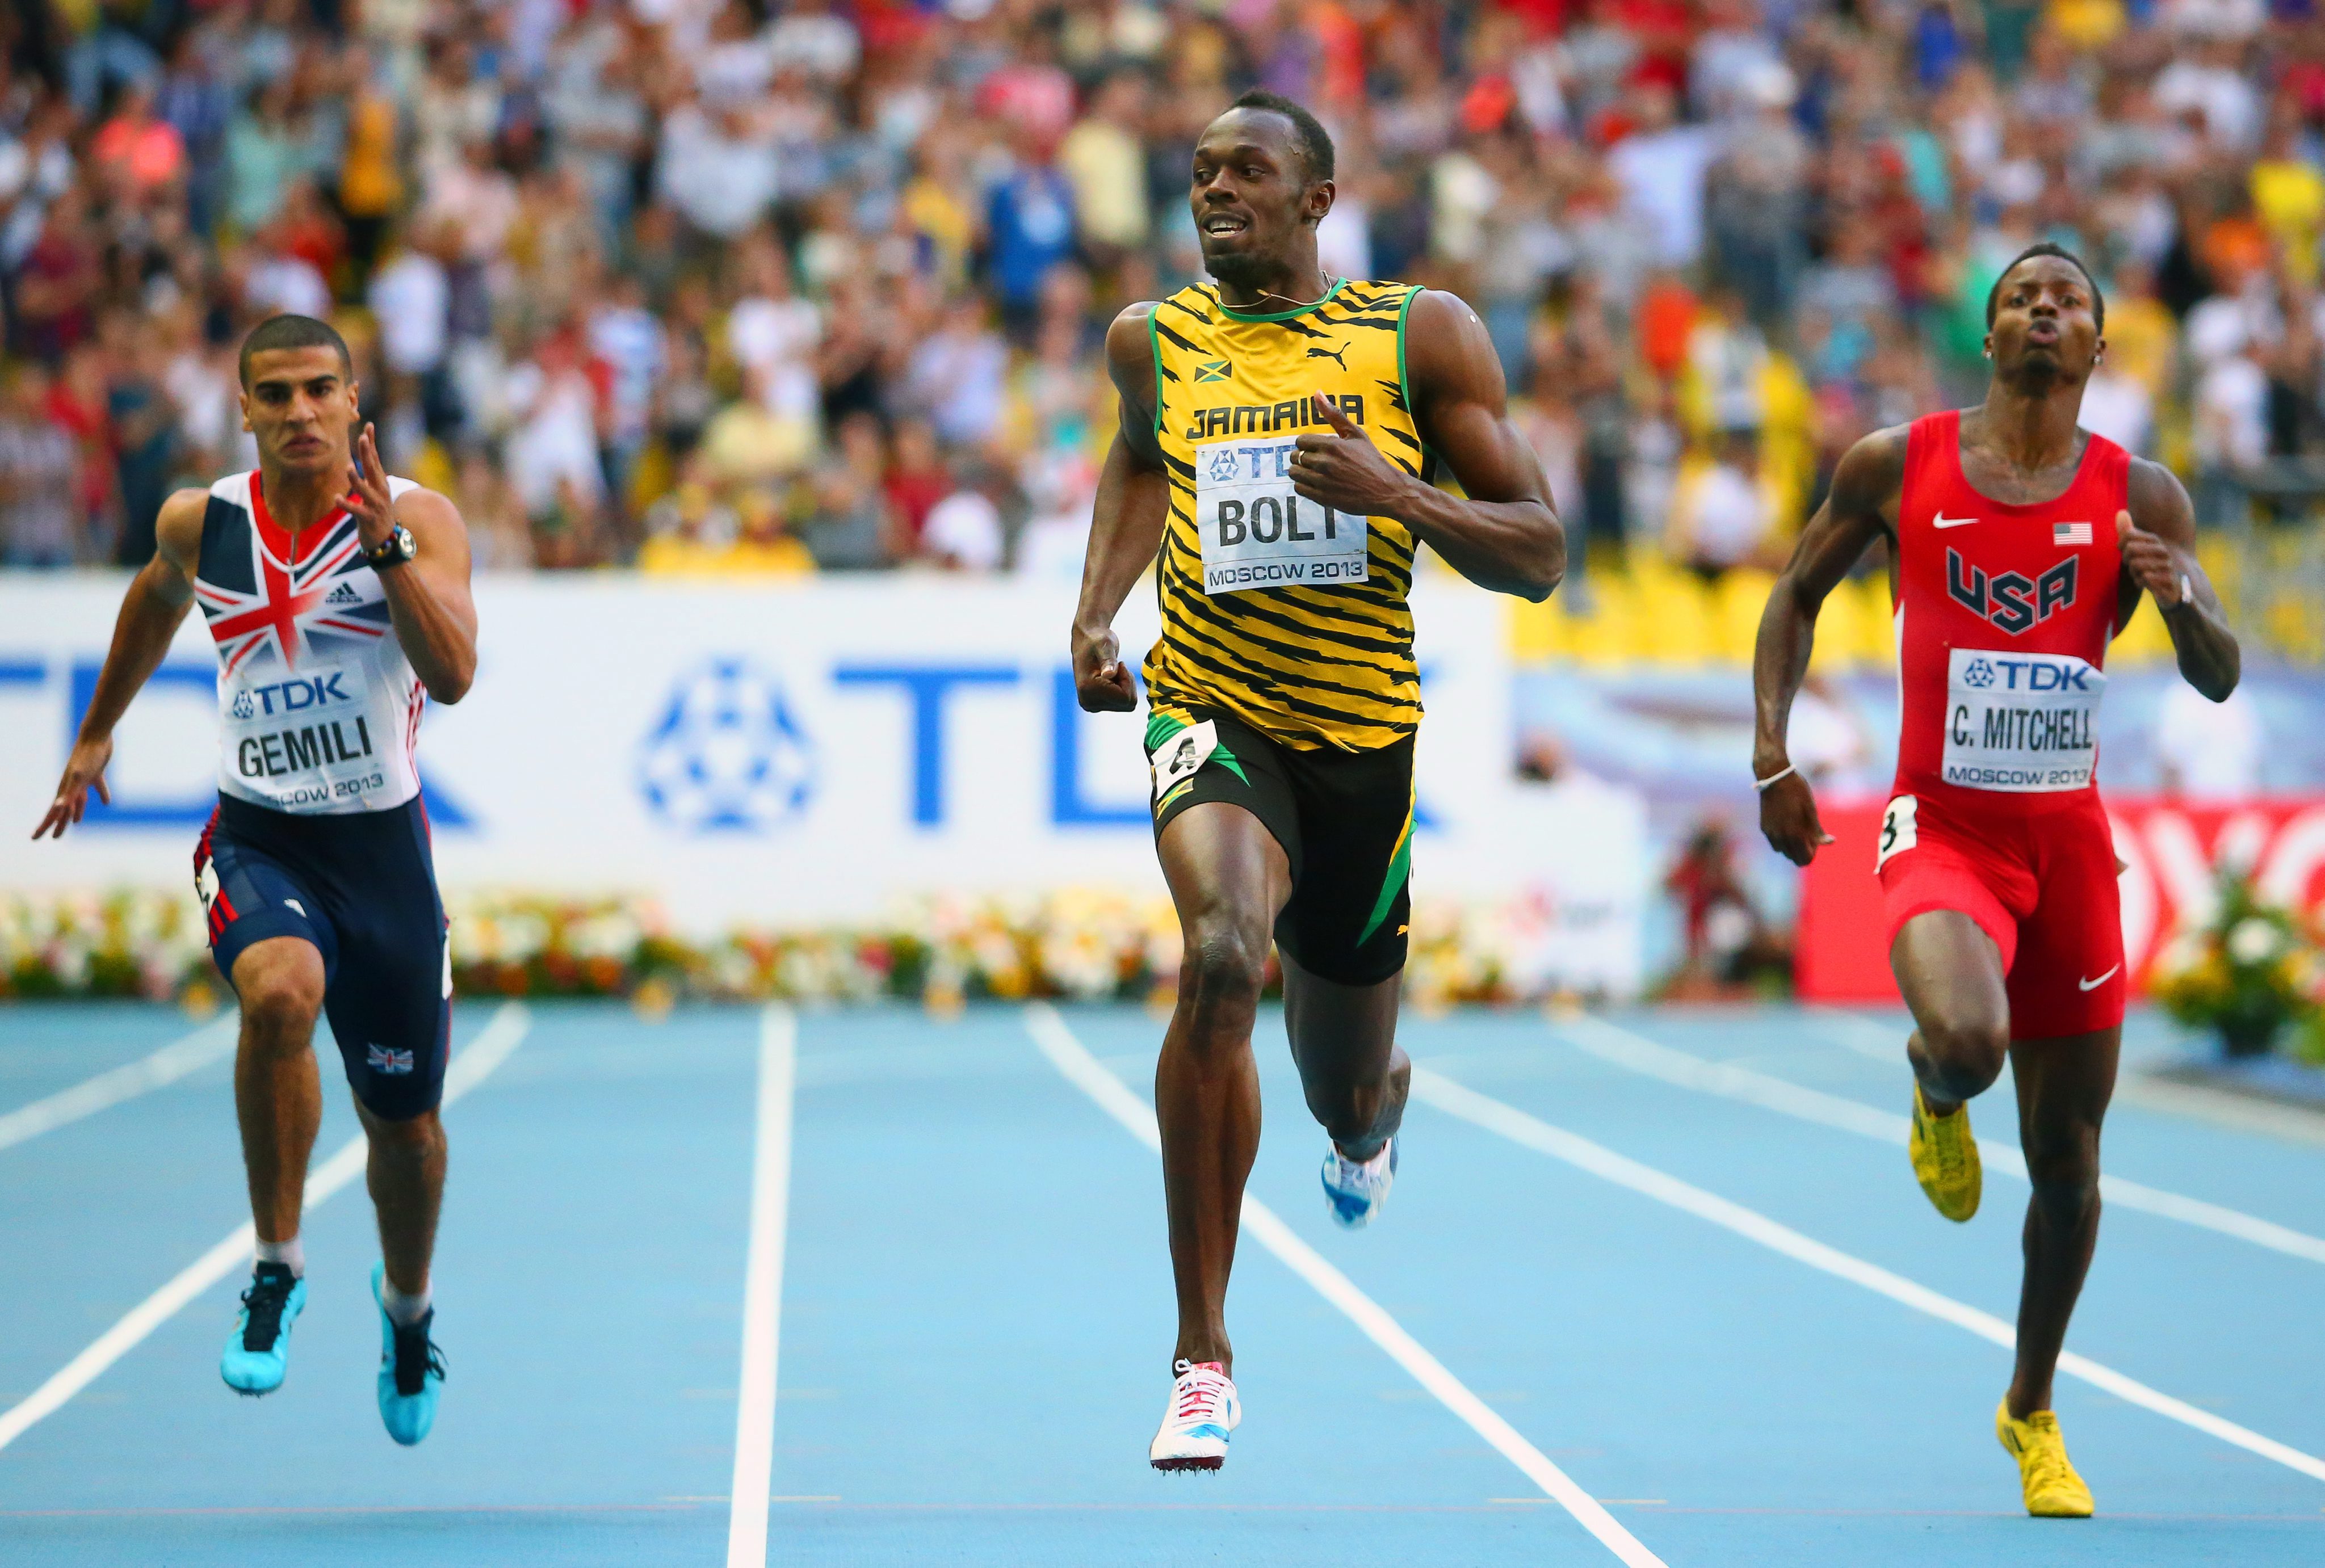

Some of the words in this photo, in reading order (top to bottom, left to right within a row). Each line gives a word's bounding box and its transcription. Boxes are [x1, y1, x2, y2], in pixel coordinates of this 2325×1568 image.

[1210, 564, 1305, 586] MOSCOW
[1312, 561, 1363, 578] 2013
[1946, 546, 2079, 636] USA
[255, 672, 350, 715] TDK
[1997, 661, 2089, 691] TDK
[238, 715, 372, 777] GEMILI
[1953, 705, 1974, 746] C.
[1986, 707, 2092, 751] MITCHELL
[1169, 736, 1200, 775] 4
[1949, 766, 2045, 784] MOSCOW
[335, 773, 384, 797] 2013
